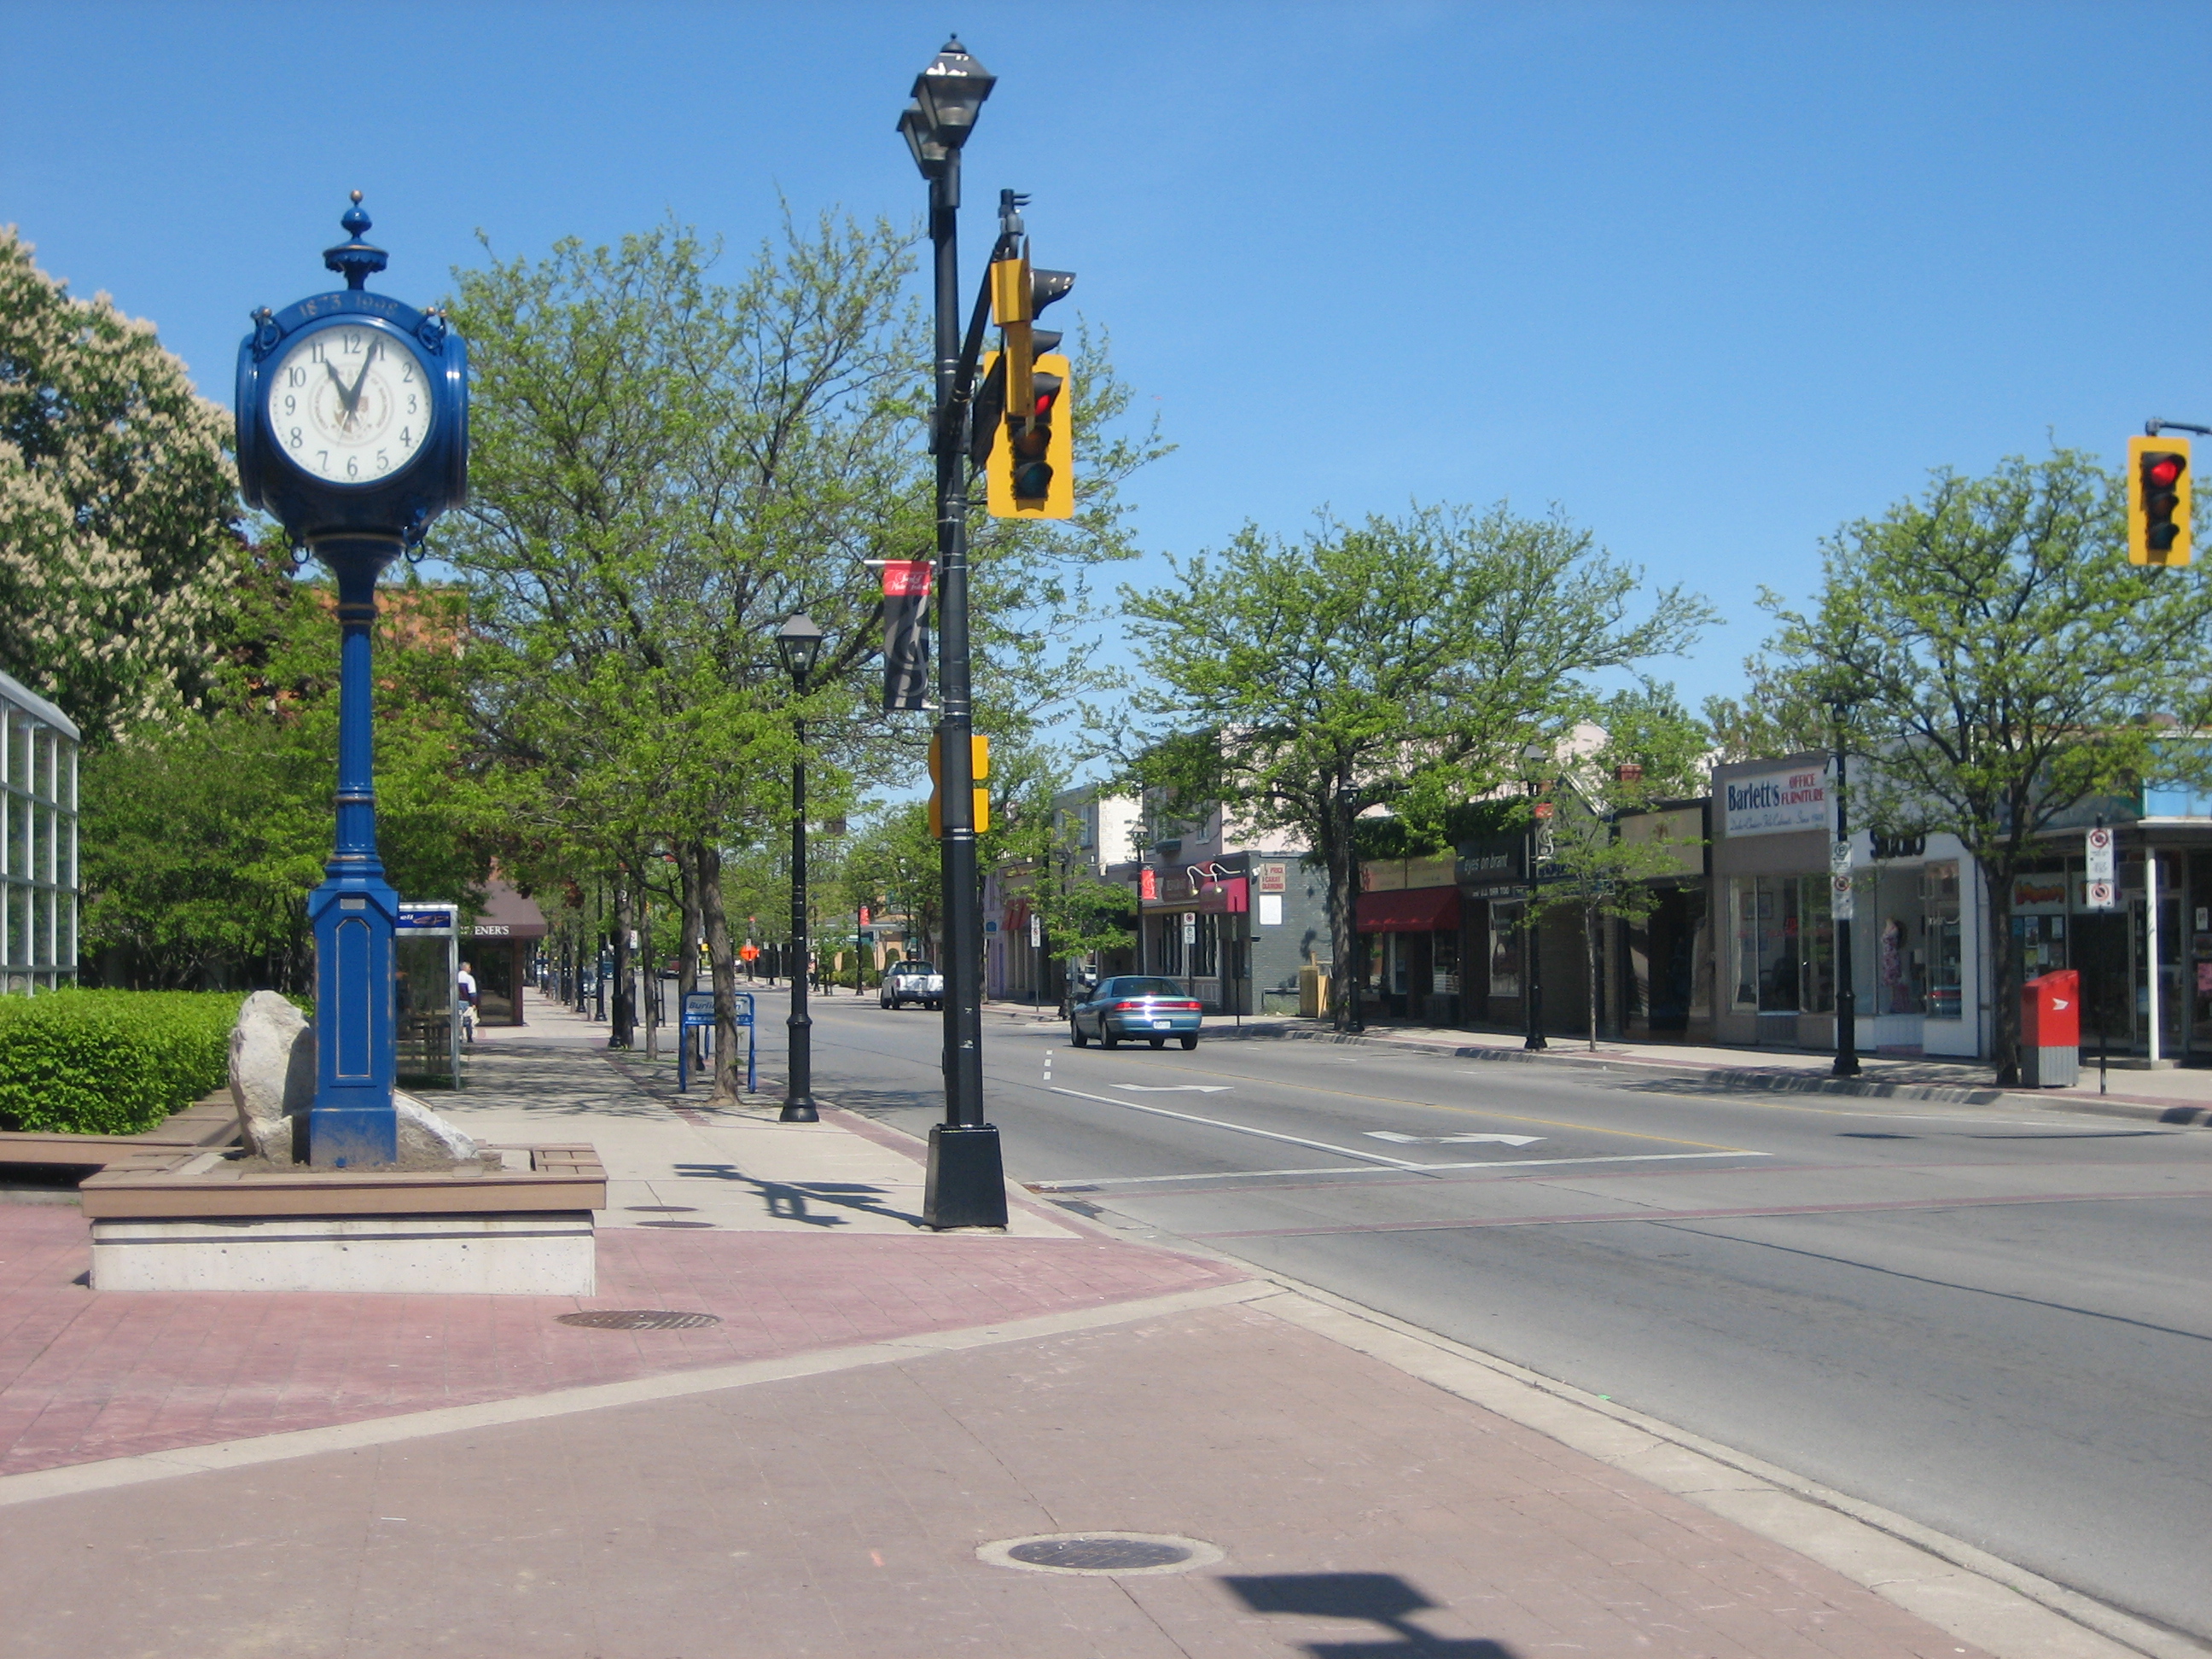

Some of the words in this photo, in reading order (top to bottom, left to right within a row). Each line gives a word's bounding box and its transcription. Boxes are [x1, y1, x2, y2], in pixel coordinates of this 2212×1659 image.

[299, 294, 341, 317] 1873
[311, 344, 324, 364] 11
[343, 334, 361, 354] 12
[376, 342, 386, 361] 1
[288, 366, 306, 387] 10
[401, 363, 414, 383] 2
[285, 395, 295, 416] 9
[406, 393, 417, 414] 3
[291, 427, 303, 448] 8
[399, 426, 411, 447] 4
[317, 450, 330, 472] 7
[346, 456, 358, 476] 6
[376, 448, 389, 469] 5
[1789, 773, 1815, 789] OFFICE
[1728, 780, 1780, 811] Barlett's
[1780, 788, 1825, 806] FURNITURE
[1464, 858, 1479, 875] eyes
[1480, 857, 1489, 870] on
[689, 1001, 742, 1010] Burlin
